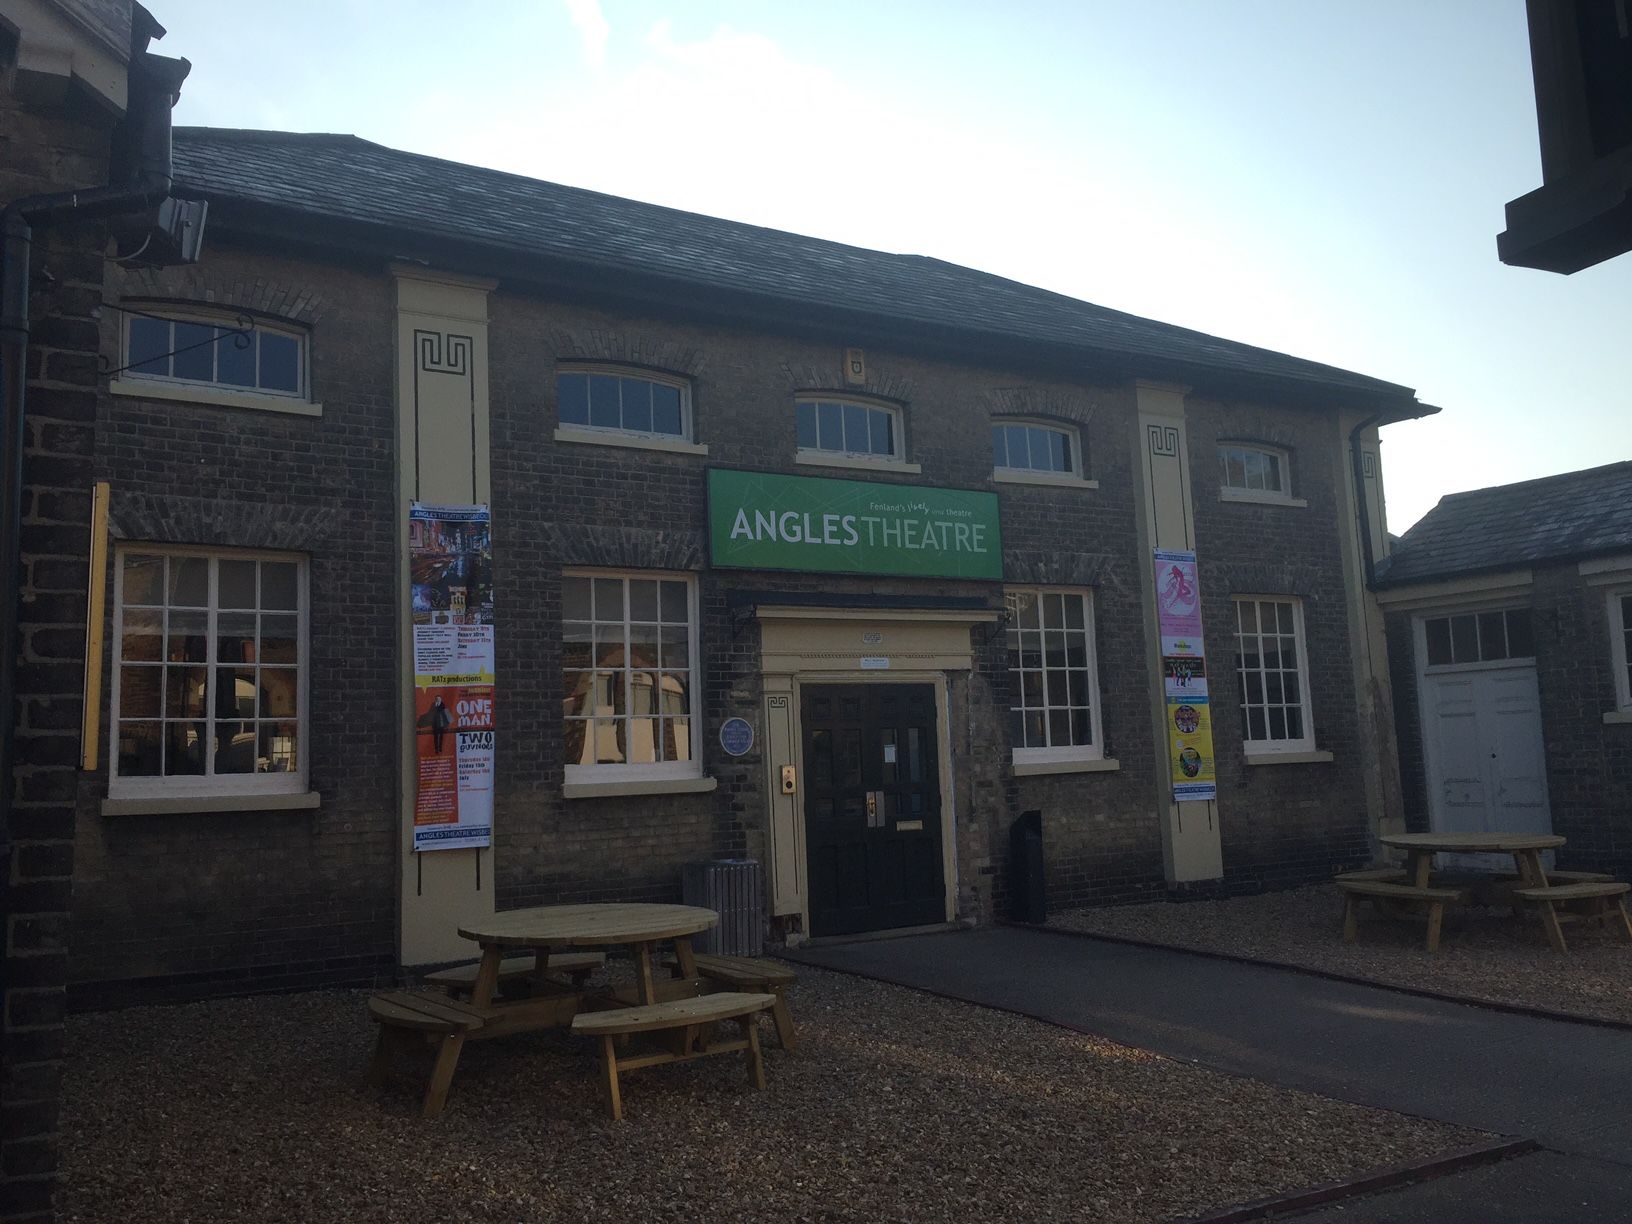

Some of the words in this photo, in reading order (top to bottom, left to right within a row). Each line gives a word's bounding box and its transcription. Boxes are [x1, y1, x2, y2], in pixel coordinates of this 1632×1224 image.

[870, 502, 906, 513] Fenland's
[907, 501, 930, 515] lively
[946, 508, 972, 517] theatre
[729, 507, 860, 546] ANGLES
[860, 516, 988, 553] THEATRE
[446, 675, 482, 684] productions
[456, 699, 492, 715] ONE
[459, 731, 493, 744] TWO
[419, 832, 443, 840] ANGLES
[444, 829, 471, 838] THEATRE
